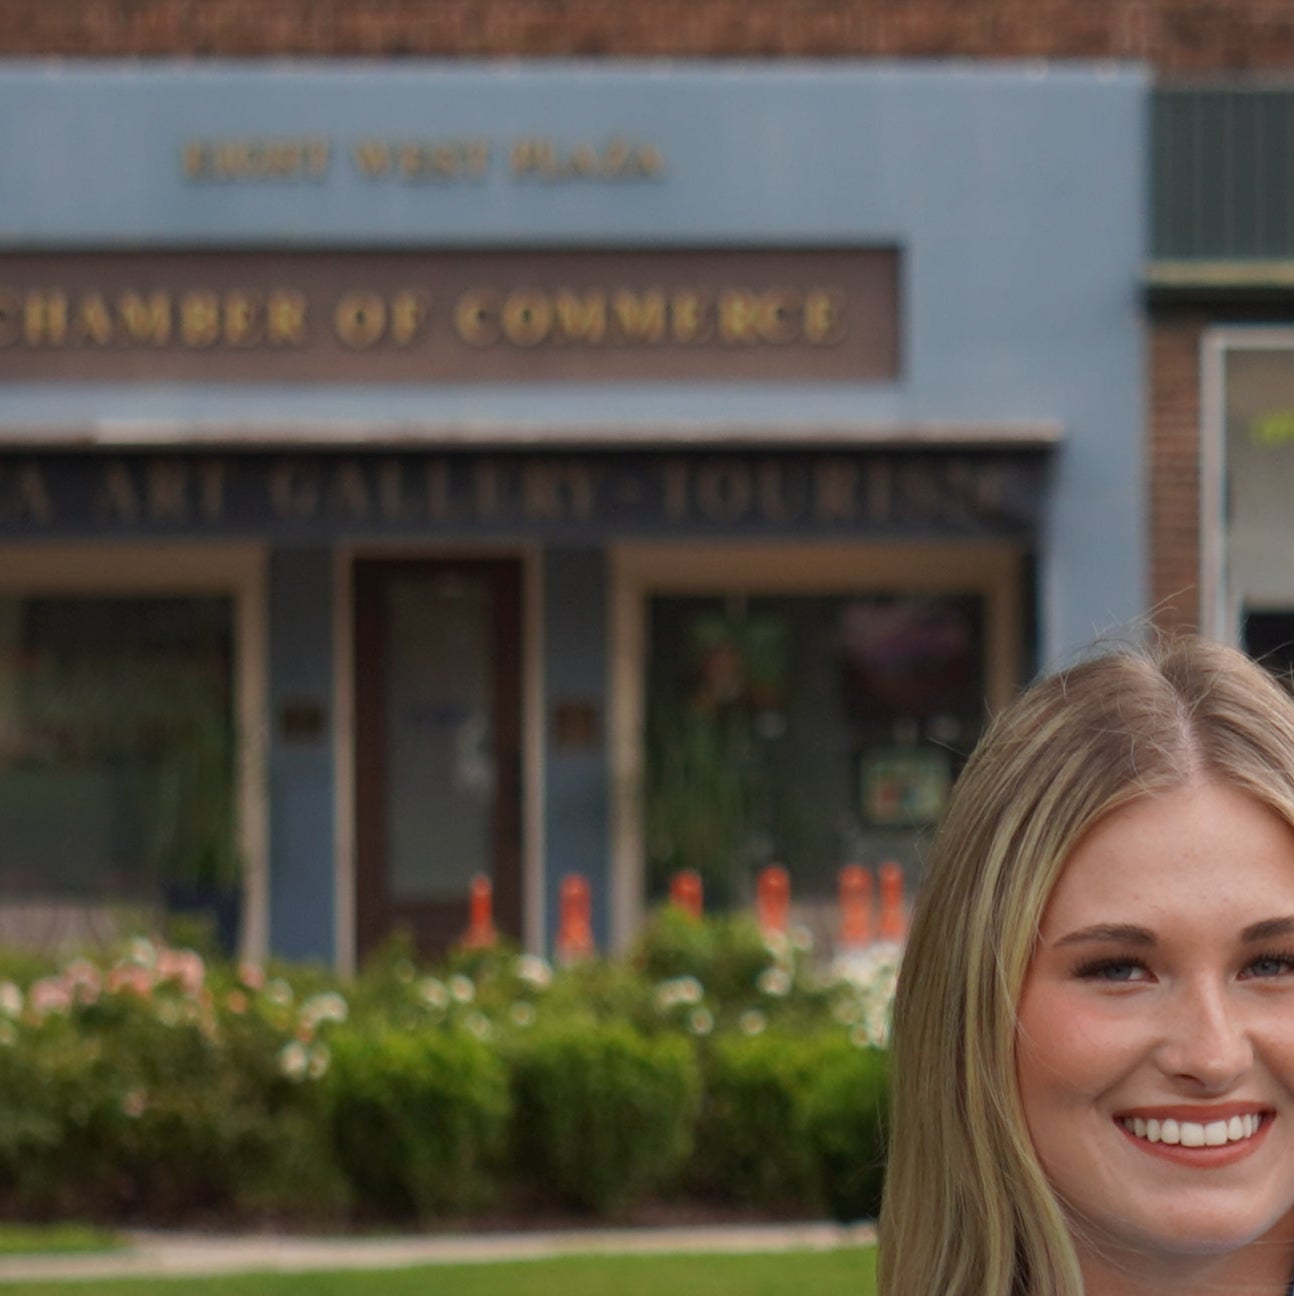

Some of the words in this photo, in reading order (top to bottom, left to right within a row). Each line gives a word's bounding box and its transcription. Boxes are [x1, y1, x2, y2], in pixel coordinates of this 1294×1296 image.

[353, 138, 489, 177] WEST
[510, 138, 664, 177] PLAZA
[335, 290, 425, 347] OF
[455, 290, 845, 347] COMMERCE
